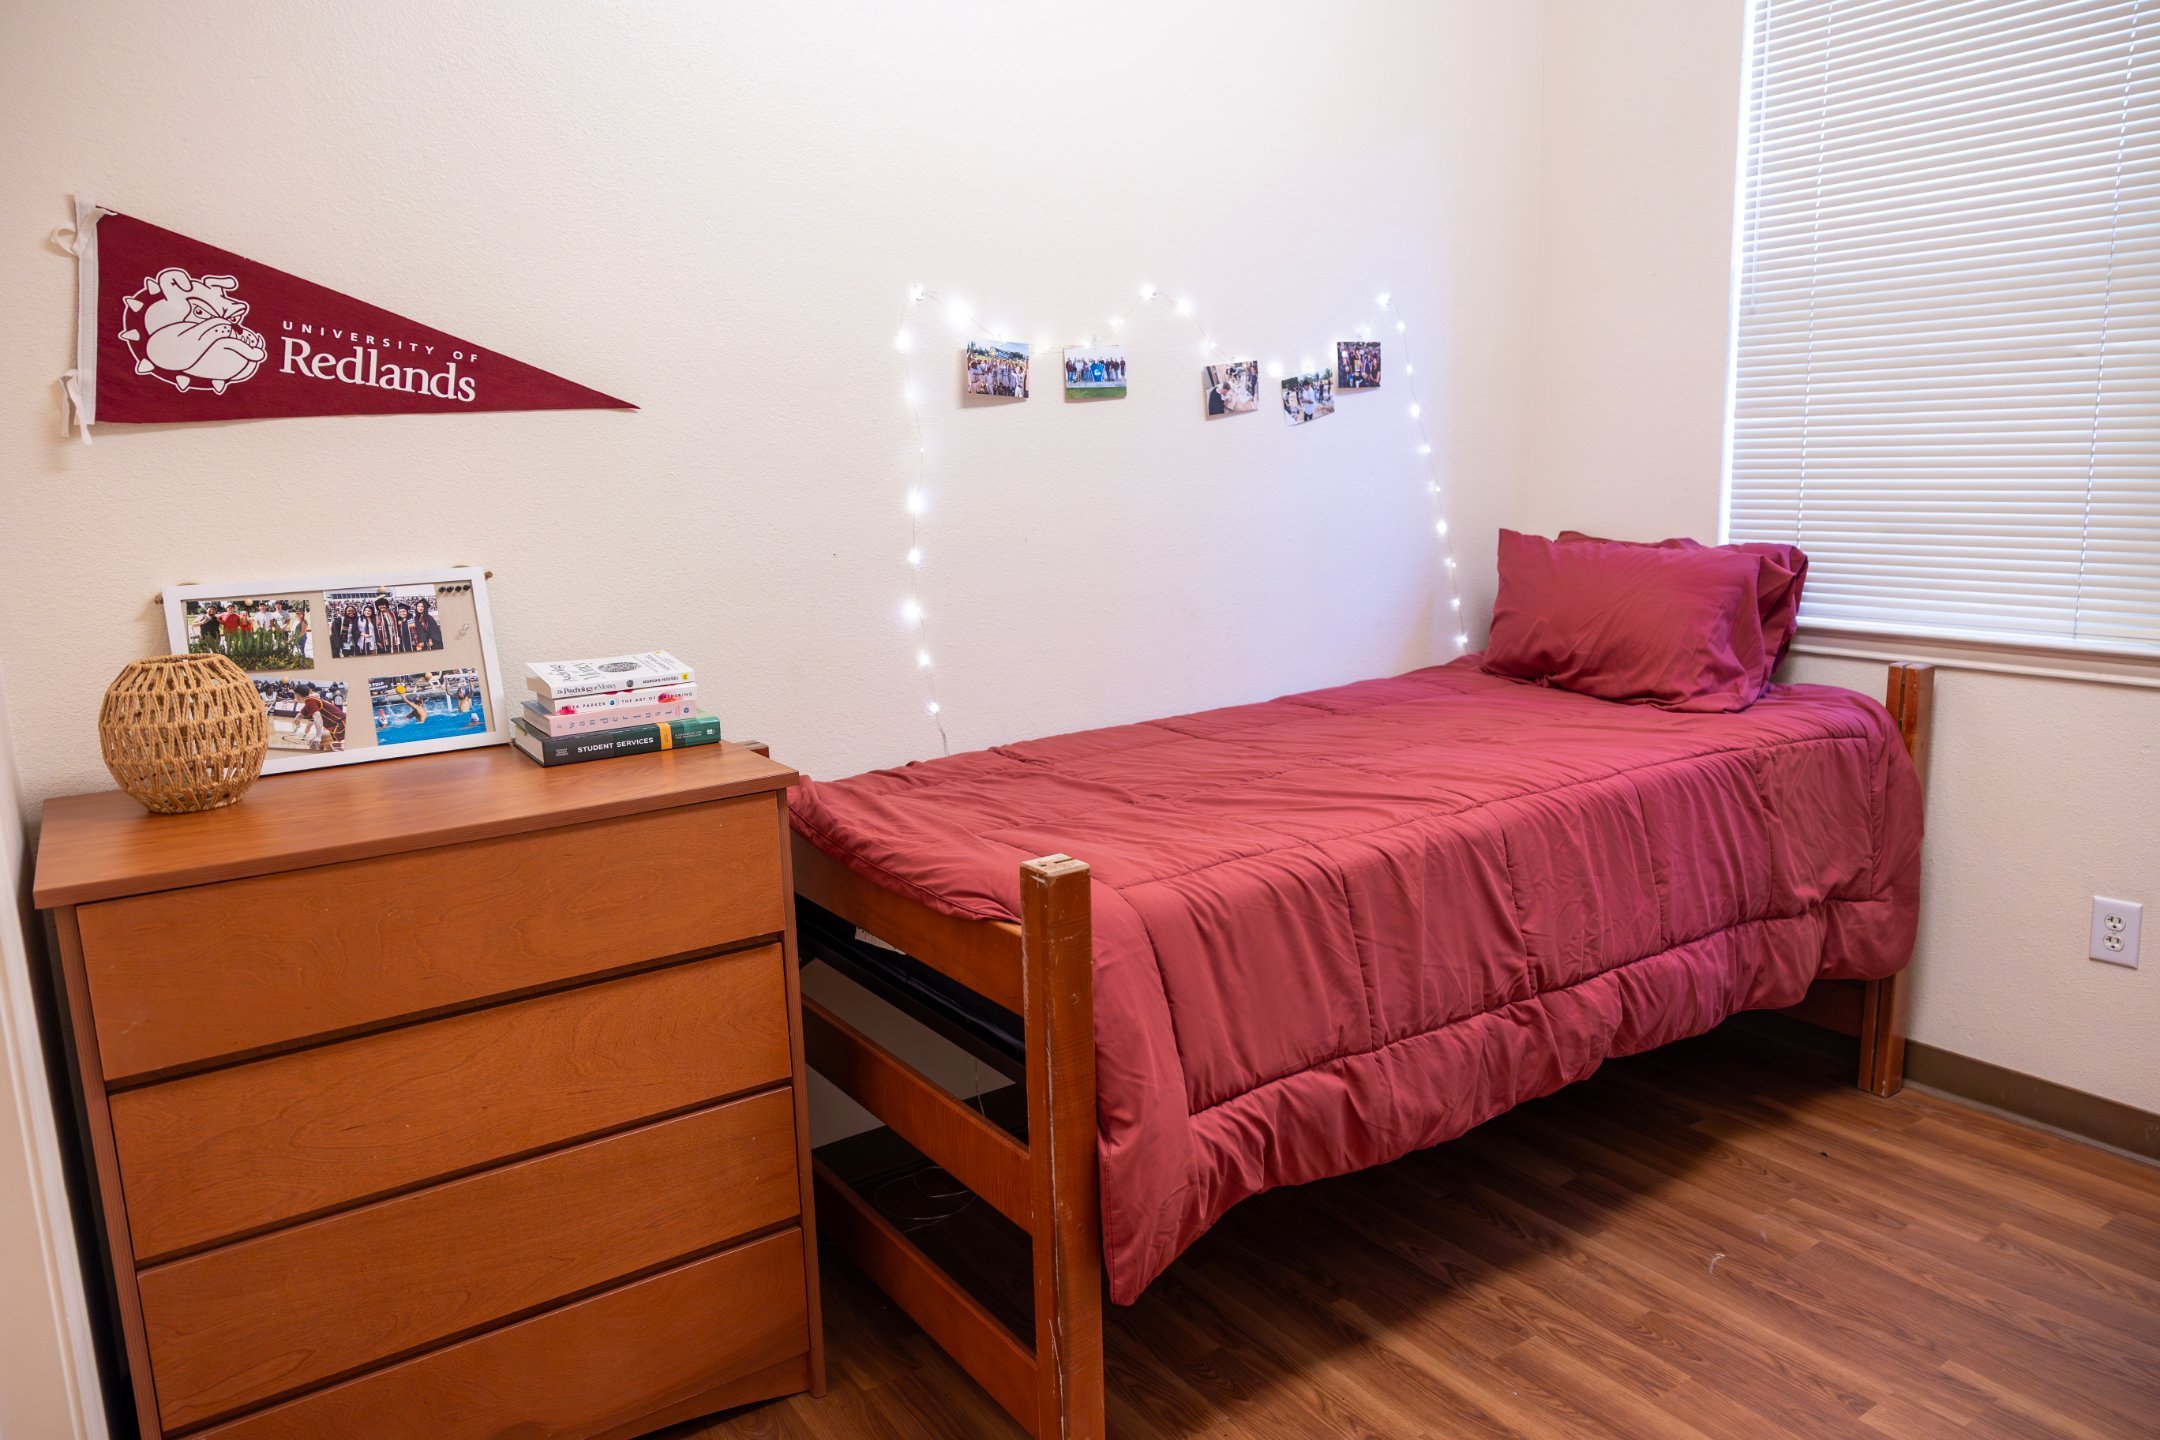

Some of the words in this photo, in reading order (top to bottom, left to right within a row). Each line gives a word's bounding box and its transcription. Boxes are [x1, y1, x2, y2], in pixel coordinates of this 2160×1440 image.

[282, 320, 434, 355] UNIVERSITY
[452, 350, 478, 363] OF
[279, 336, 476, 402] Redlands
[577, 742, 614, 753] STUDENT
[616, 737, 654, 748] SERVICES
